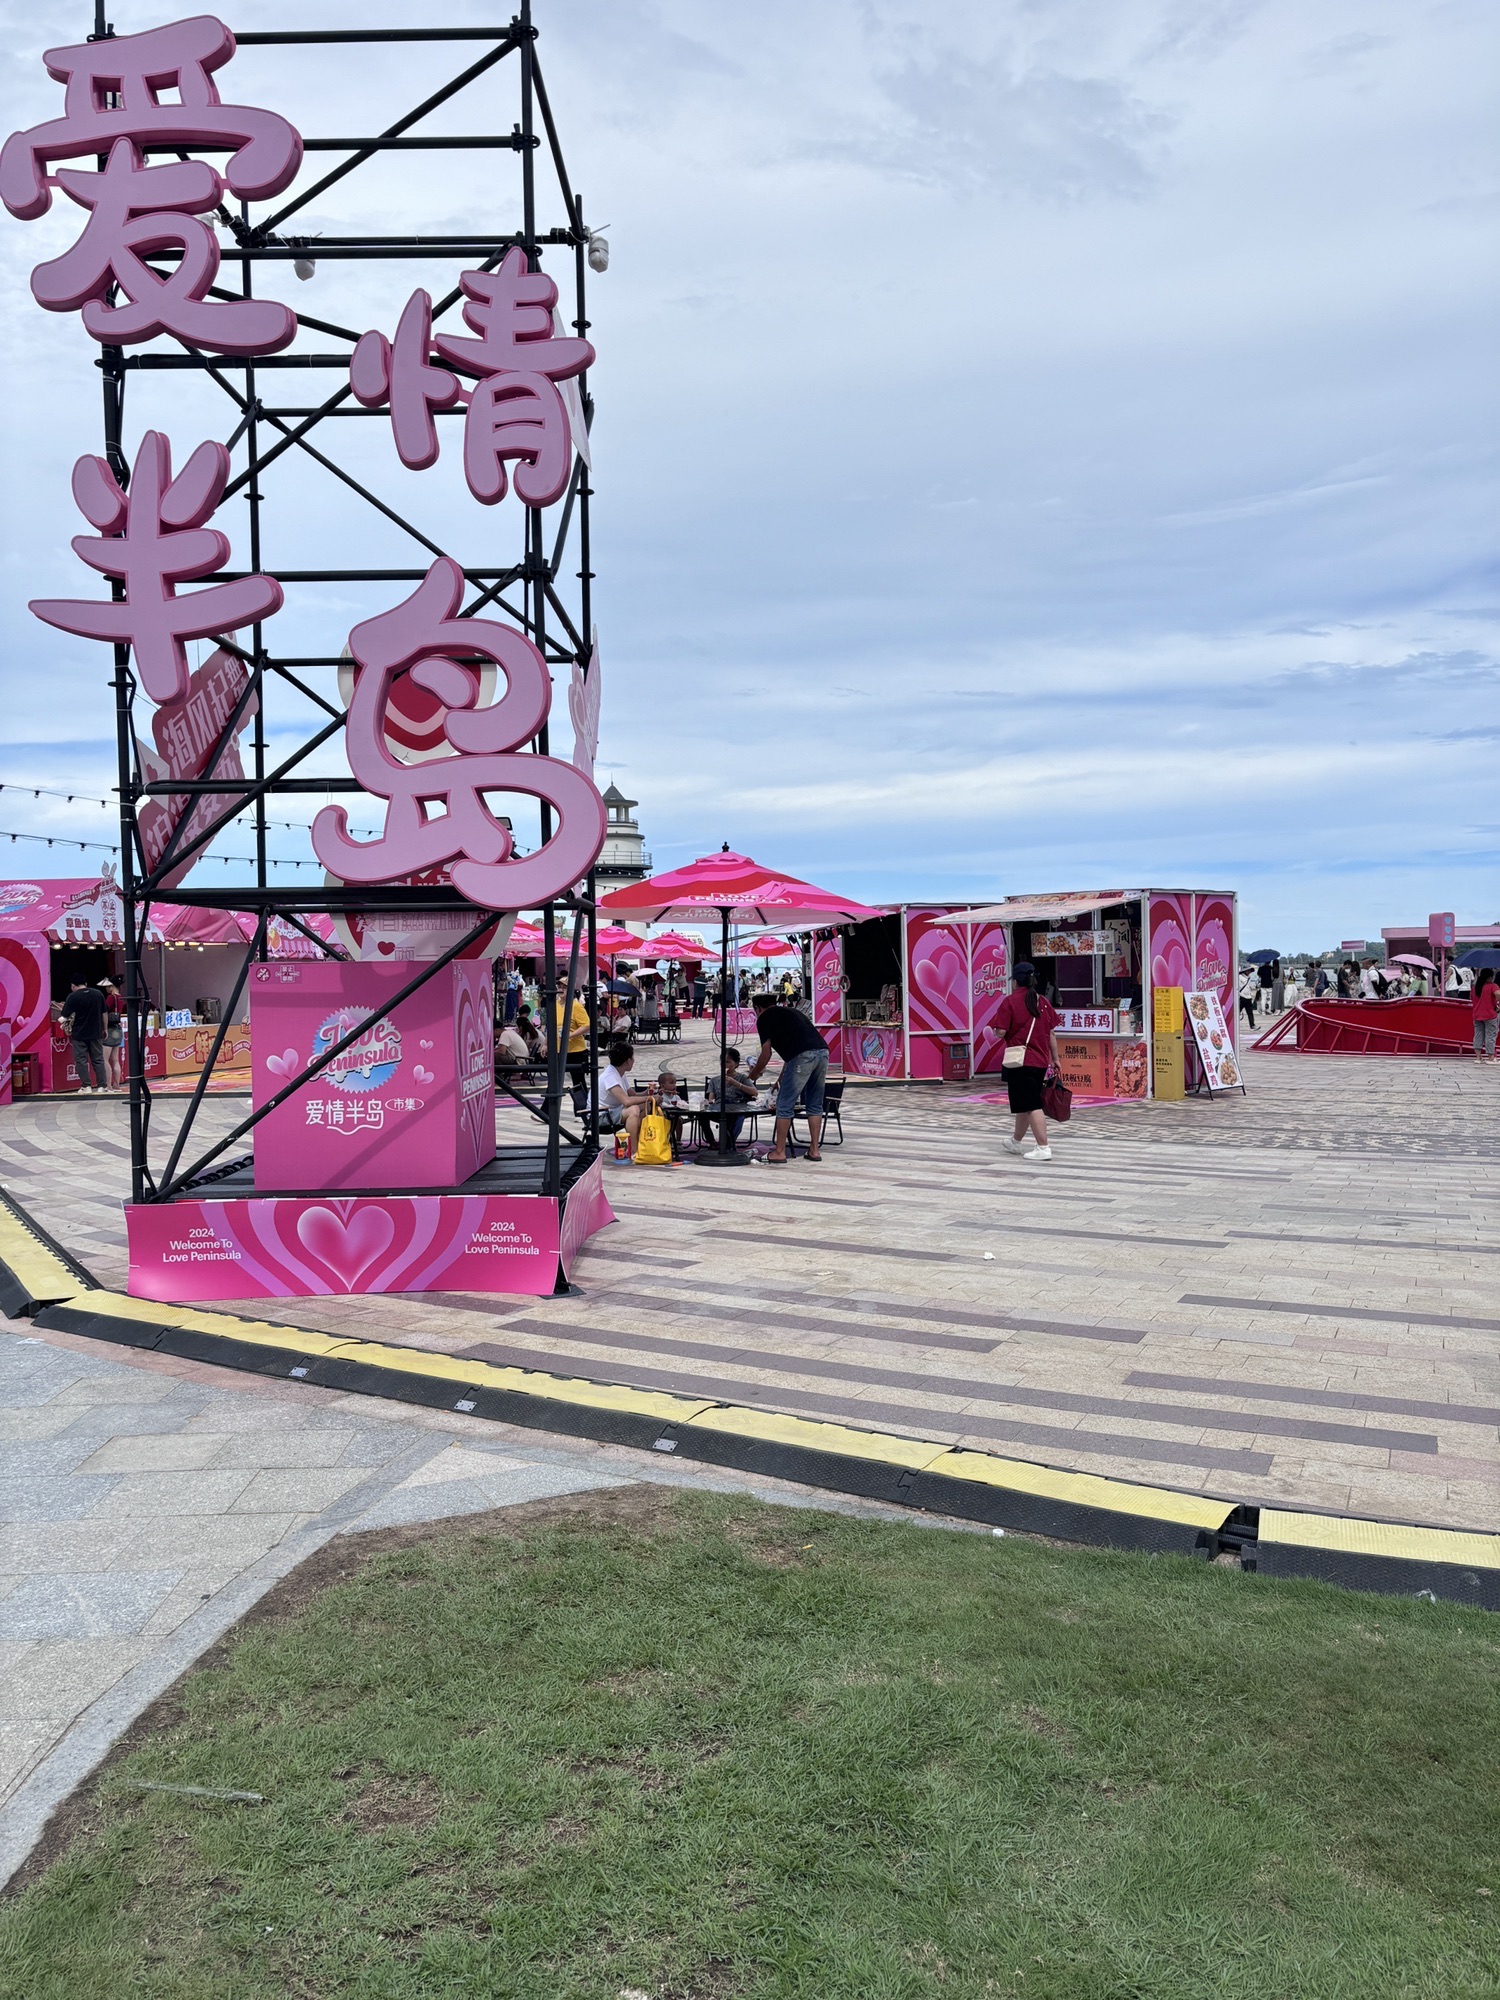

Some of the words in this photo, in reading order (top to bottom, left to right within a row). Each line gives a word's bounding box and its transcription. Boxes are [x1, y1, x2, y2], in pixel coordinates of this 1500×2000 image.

[65, 917, 90, 929] 章鱼烧
[1200, 958, 1227, 979] Love
[1071, 1013, 1110, 1029] 盐酥鸡
[1065, 1045, 1087, 1055] 盐酥鸡
[471, 1055, 485, 1073] LOVE
[463, 1072, 491, 1097] PENINSULA
[305, 1099, 384, 1135] 爱情半岛
[393, 1098, 416, 1111] 市集
[189, 1228, 215, 1238] 2024
[490, 1222, 516, 1231] 2024
[170, 1240, 220, 1251] Welcome
[220, 1238, 233, 1249] To
[471, 1233, 520, 1243] Welcome
[520, 1233, 532, 1244] To
[163, 1252, 189, 1263] Love
[190, 1250, 242, 1262] Peninsula
[465, 1244, 490, 1254] Love
[491, 1244, 540, 1256] Peninsula
